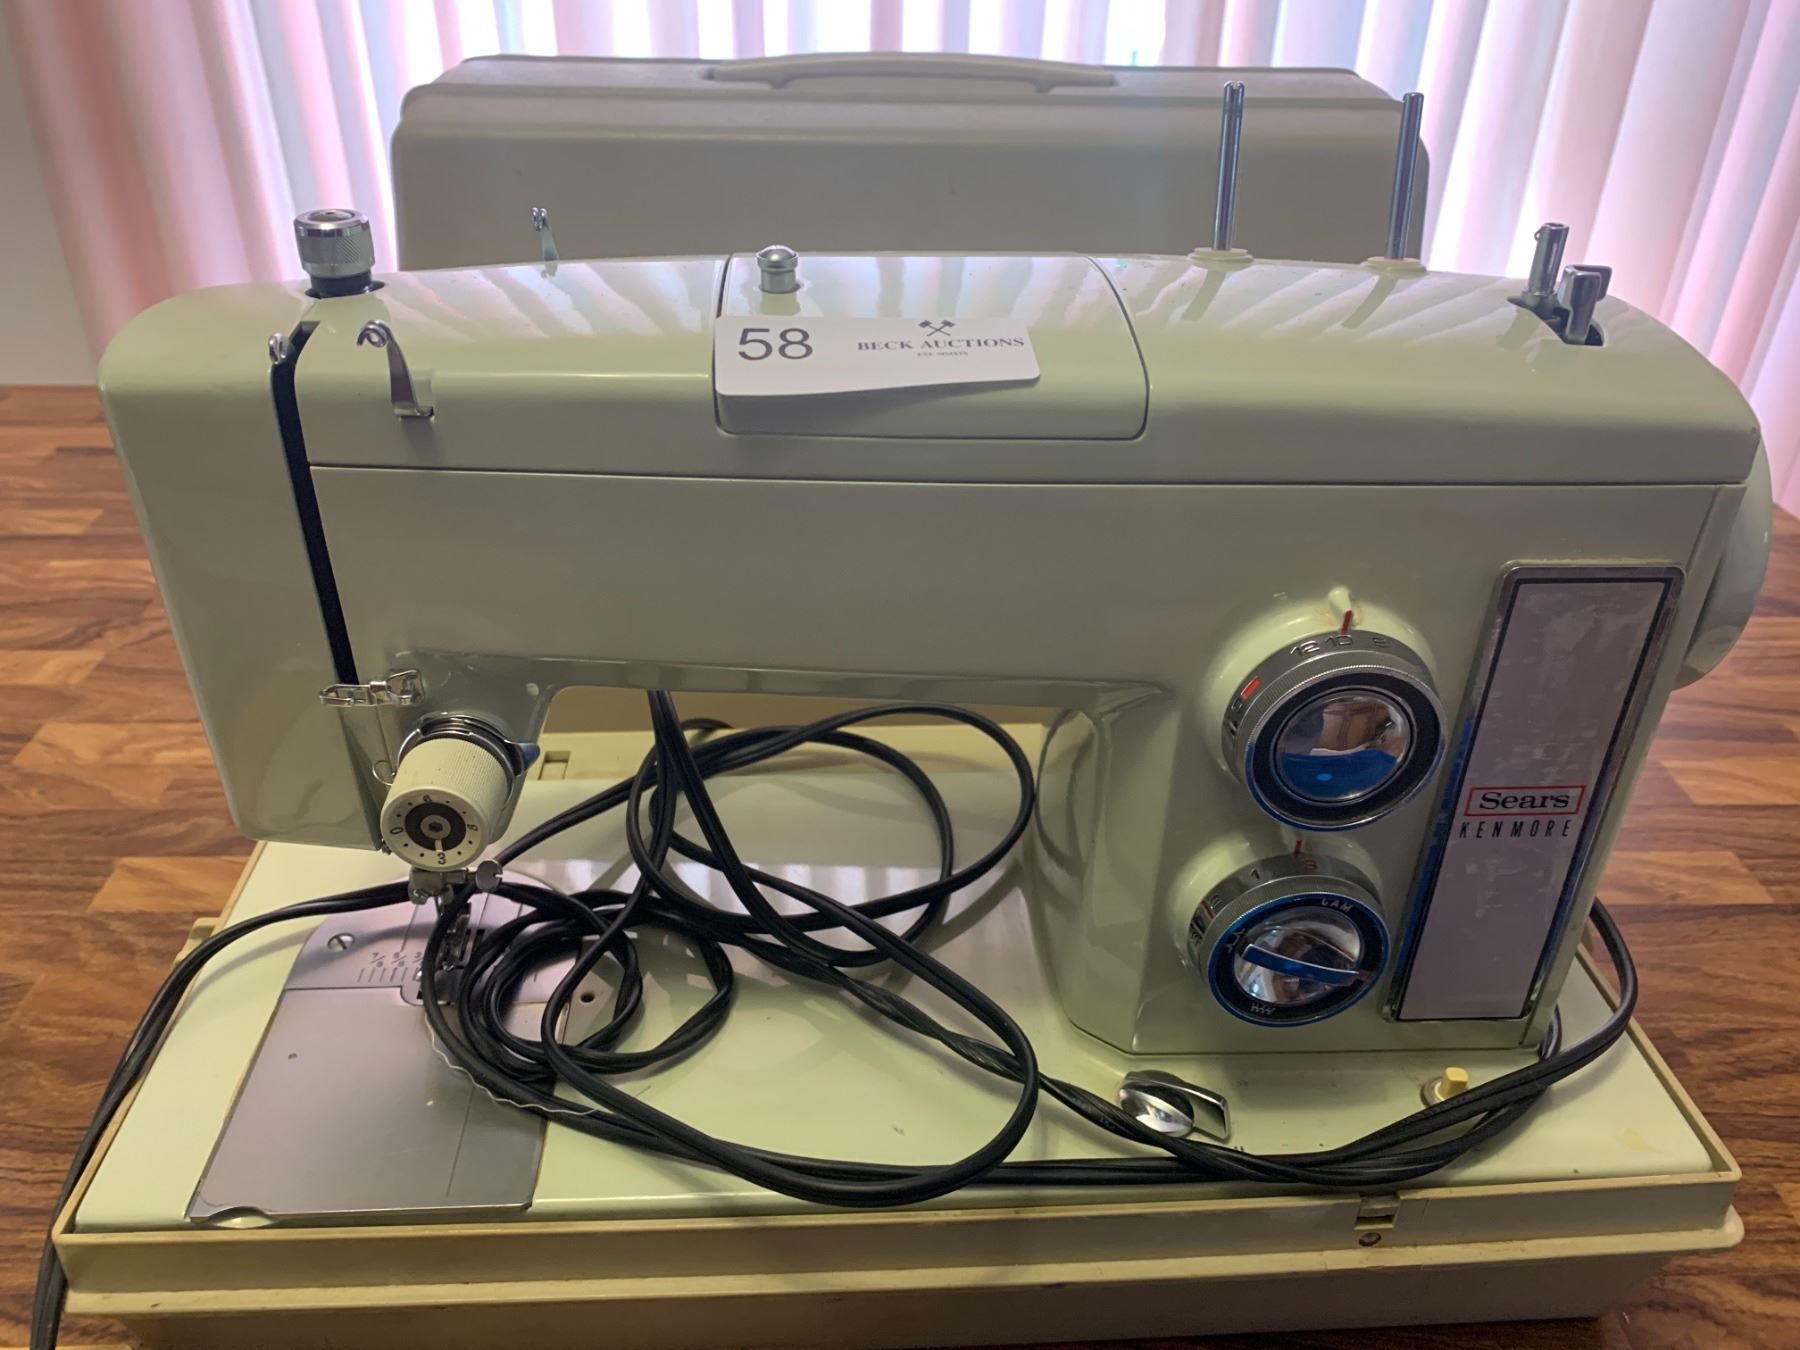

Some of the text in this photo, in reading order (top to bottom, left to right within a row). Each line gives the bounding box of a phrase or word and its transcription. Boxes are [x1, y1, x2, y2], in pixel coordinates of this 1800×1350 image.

[737, 327, 1025, 361] 58 BECK AUCTIONS
[1479, 791, 1570, 810] Sears
[390, 826, 404, 835] 0
[1459, 819, 1572, 839] KENMORE
[437, 852, 447, 865] 3
